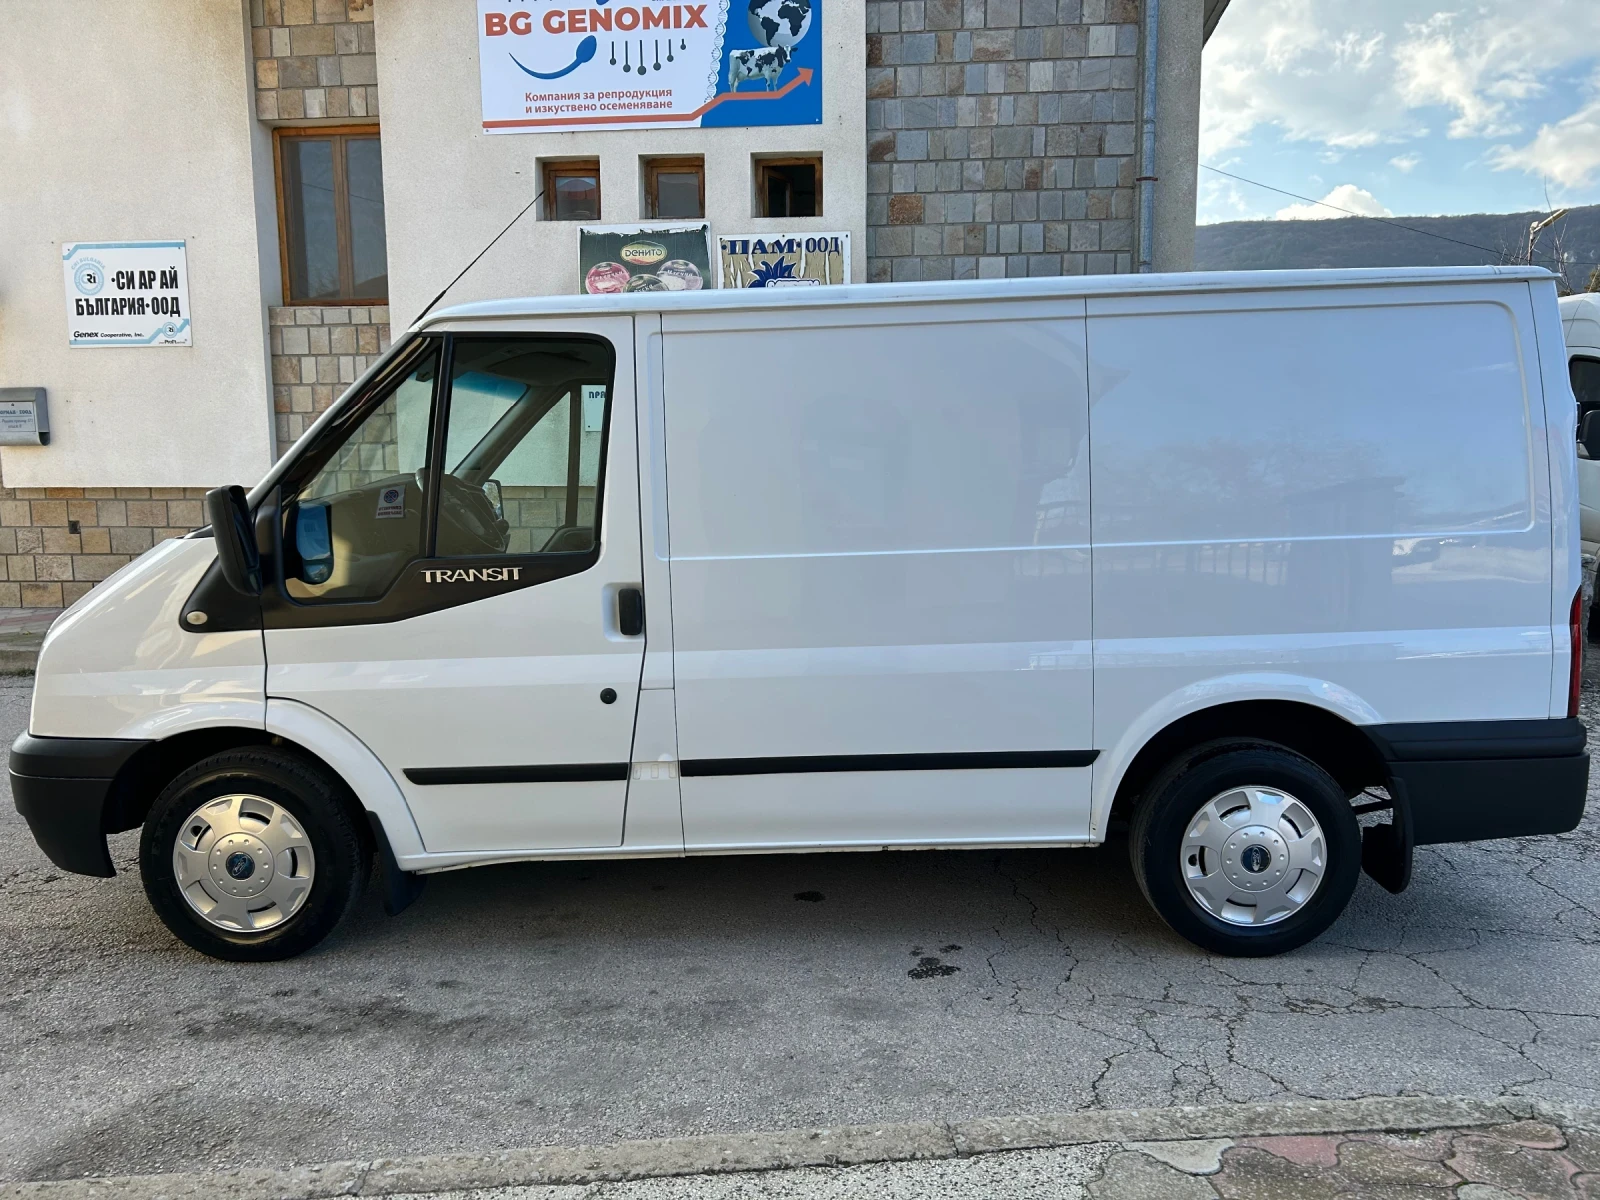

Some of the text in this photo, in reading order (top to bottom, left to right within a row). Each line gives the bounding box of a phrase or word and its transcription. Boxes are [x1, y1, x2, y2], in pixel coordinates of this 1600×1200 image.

[484, 4, 708, 36] BG GENOMIX
[525, 89, 672, 102] Компания за репродукция
[525, 100, 673, 115] и изкуствено осеменяване
[805, 236, 840, 256] ООД
[138, 270, 157, 290] АР
[160, 265, 179, 289] АЙ
[73, 330, 99, 338] Genex
[420, 566, 523, 583] TRANSIT
